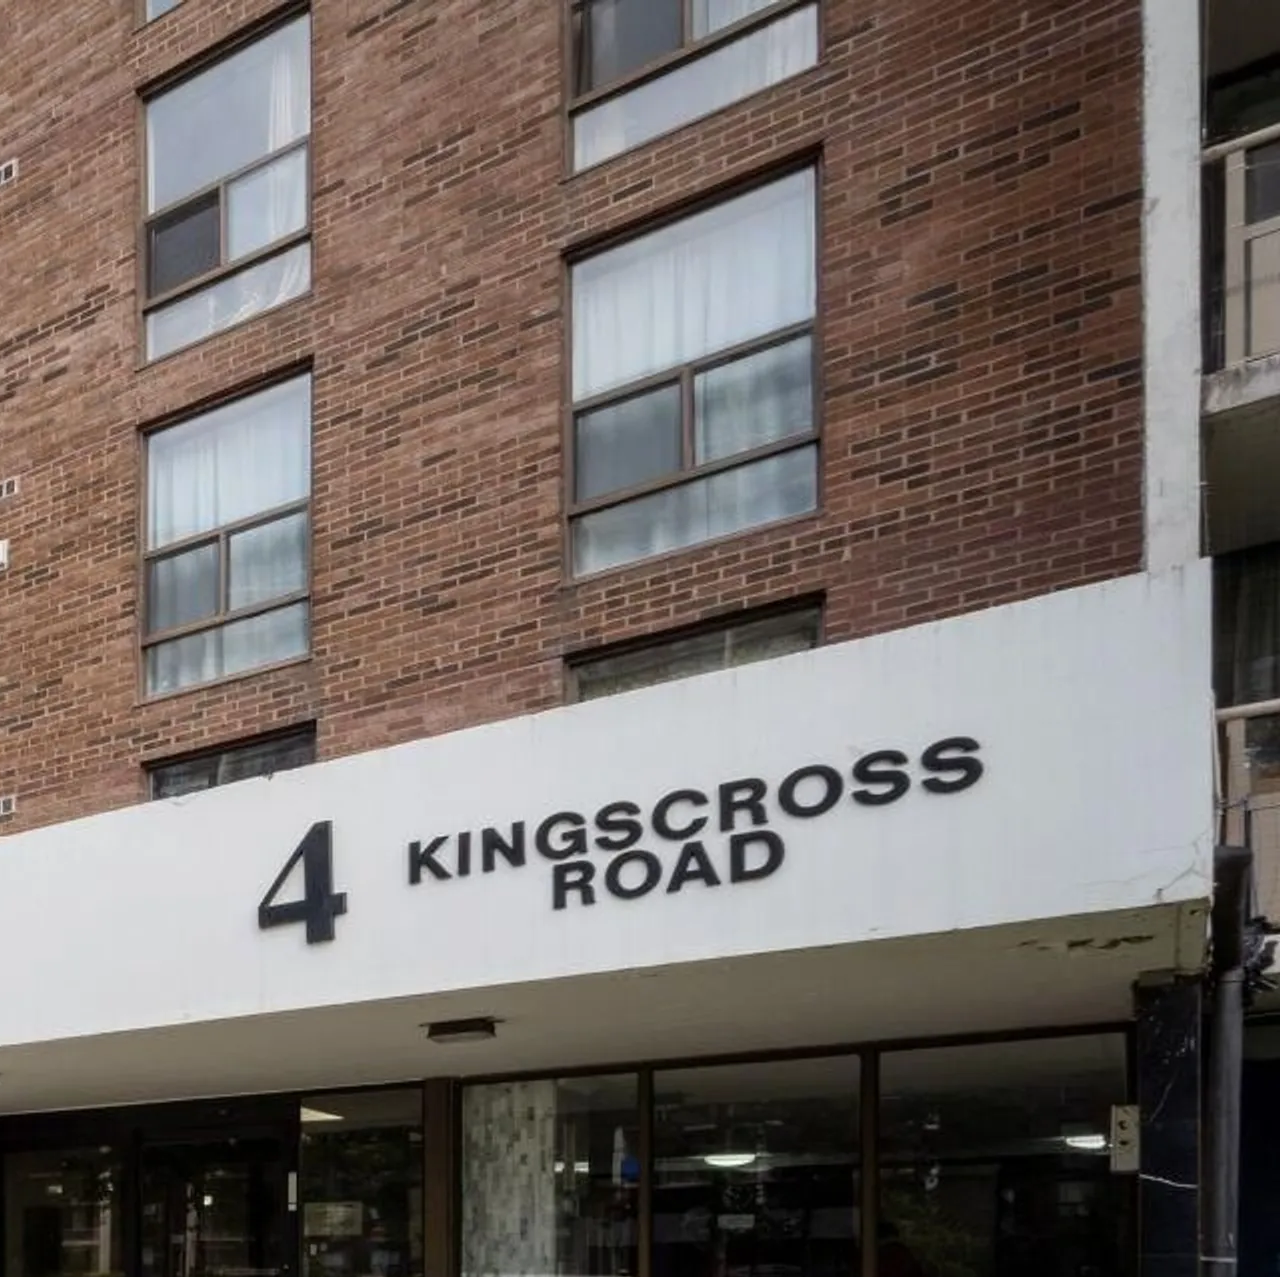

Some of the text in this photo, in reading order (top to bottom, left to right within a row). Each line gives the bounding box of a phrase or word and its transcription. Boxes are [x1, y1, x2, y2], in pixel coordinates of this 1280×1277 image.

[258, 736, 984, 944] 4 KINGSCROSS
[552, 830, 785, 910] ROAD
